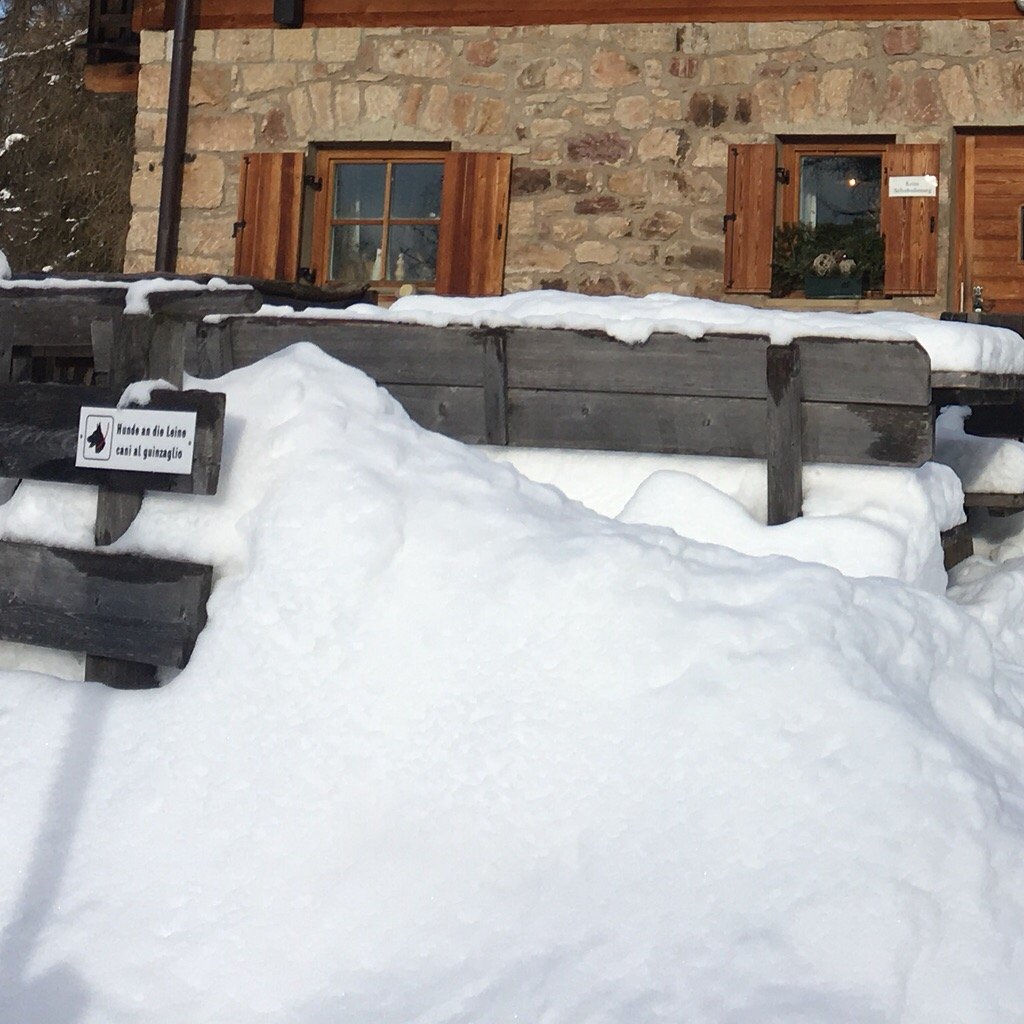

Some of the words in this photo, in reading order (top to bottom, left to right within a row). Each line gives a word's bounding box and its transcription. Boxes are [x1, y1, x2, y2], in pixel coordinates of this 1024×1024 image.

[116, 423, 139, 436] Hunde
[141, 426, 151, 436] an
[152, 424, 164, 437] die
[166, 425, 187, 438] Leine
[116, 444, 132, 456] cani
[133, 445, 142, 457] al
[143, 446, 183, 461] guinzaglio
